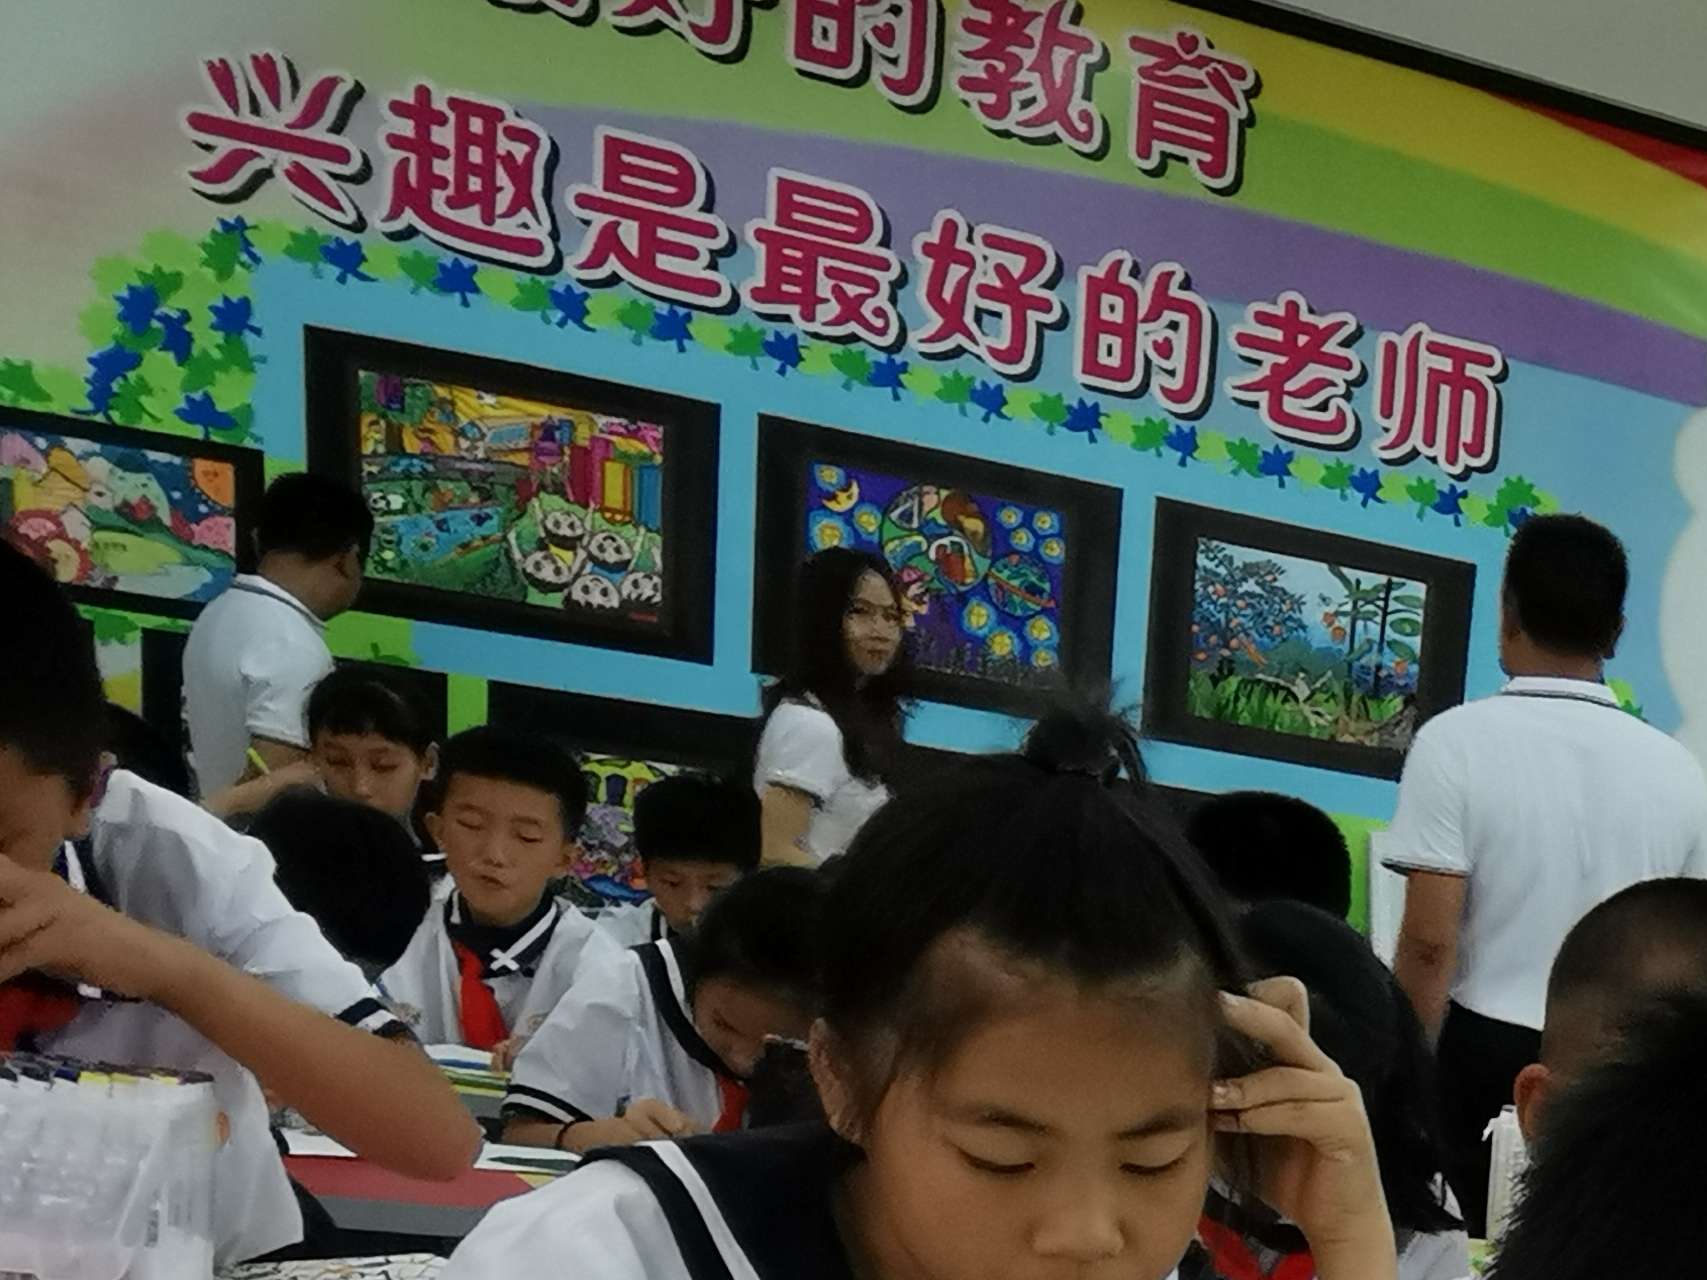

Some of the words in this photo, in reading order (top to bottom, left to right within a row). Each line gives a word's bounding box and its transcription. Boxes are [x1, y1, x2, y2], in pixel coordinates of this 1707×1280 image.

[492, 0, 1260, 190] 的教育
[184, 50, 1510, 476] 兴趣是最好的老师
